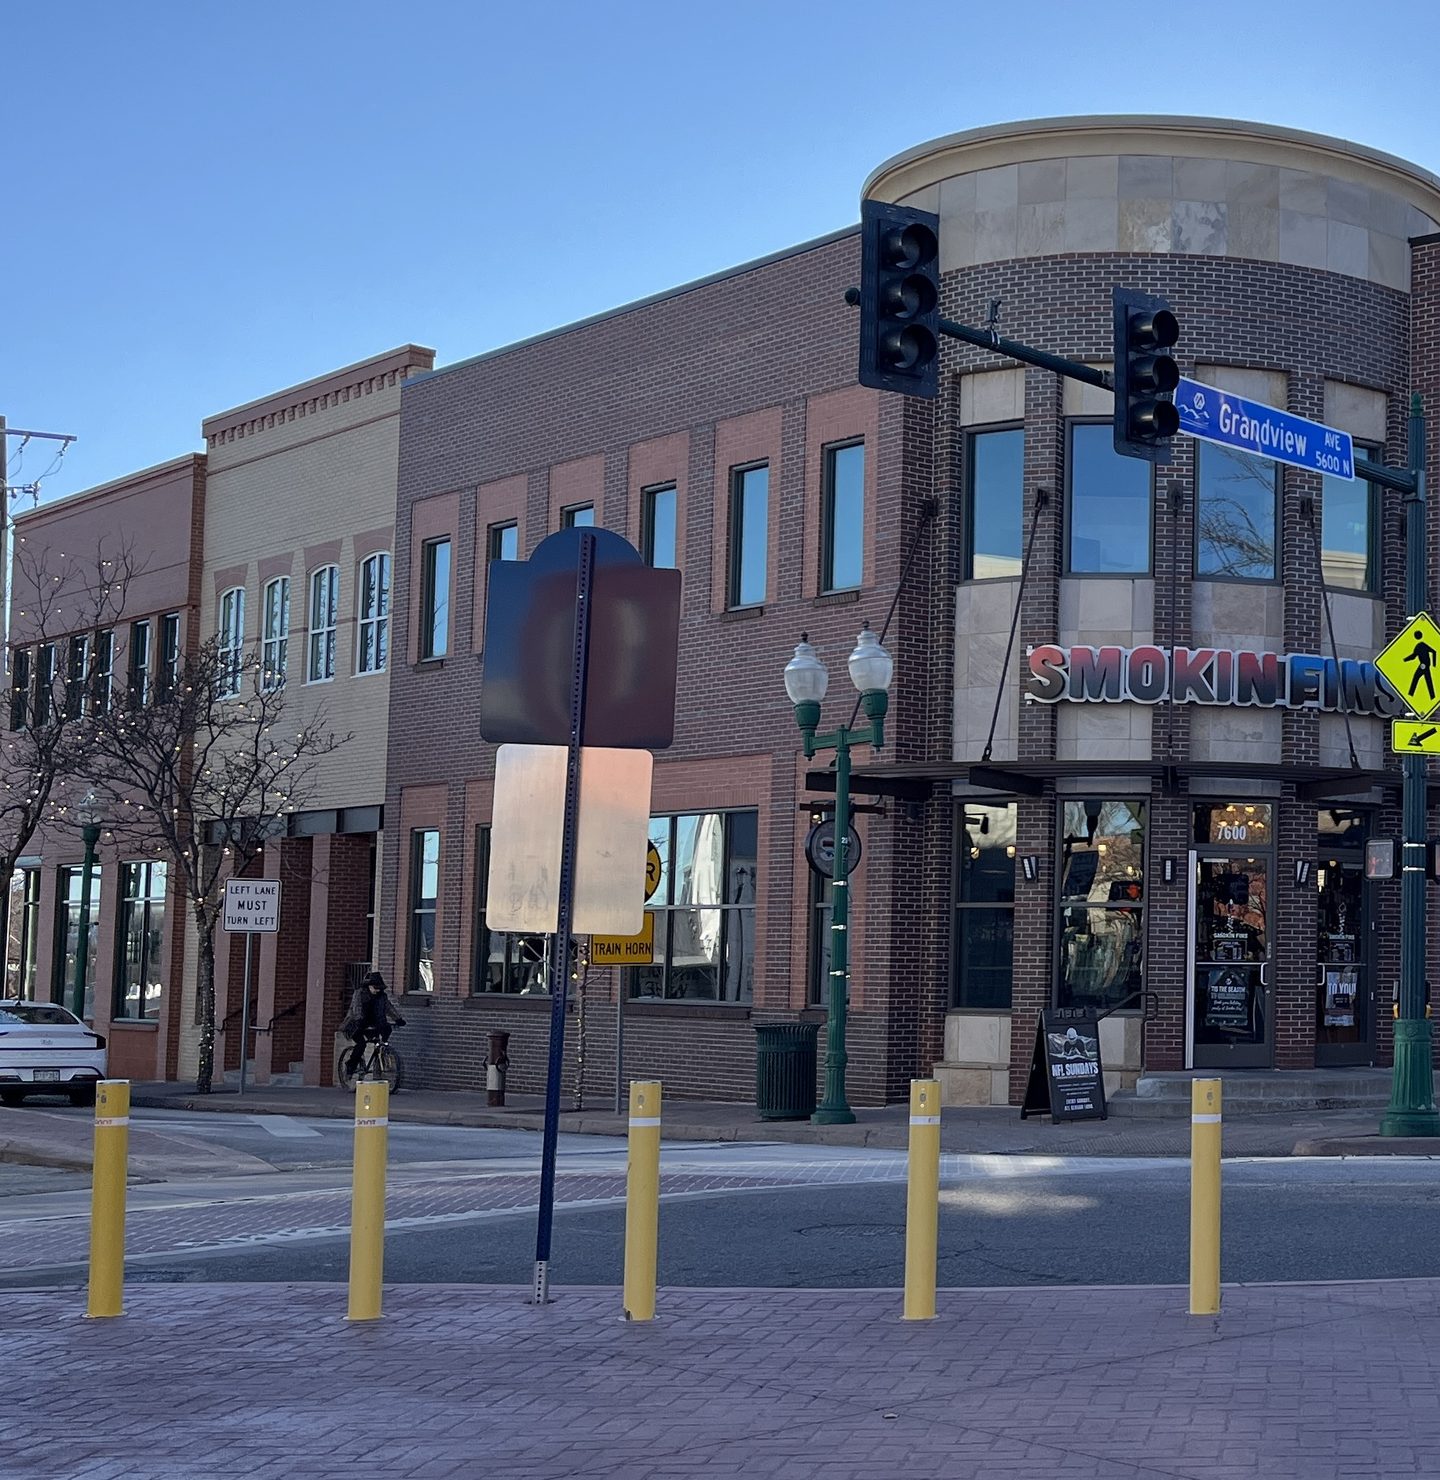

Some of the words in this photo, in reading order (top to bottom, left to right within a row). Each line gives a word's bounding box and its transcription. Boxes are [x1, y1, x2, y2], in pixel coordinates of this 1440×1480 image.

[1219, 403, 1307, 457] Grandview
[1324, 431, 1341, 451] AVE
[1315, 450, 1340, 473] 5600
[1343, 459, 1350, 475] N
[1028, 645, 1278, 705] SMOKIN
[1288, 653, 1404, 717] FINS
[1216, 825, 1247, 840] 7600
[646, 862, 655, 881] R
[230, 886, 250, 895] LEFT
[255, 886, 276, 895] LANE
[237, 900, 267, 911] MUST
[227, 916, 248, 925] TURN
[254, 917, 275, 926] LEFT
[594, 942, 622, 956] TRAIN
[625, 942, 652, 956] HORN
[1328, 983, 1337, 995] TO
[1051, 1063, 1065, 1077] NFL
[1065, 1062, 1099, 1076] SUNDAYS
